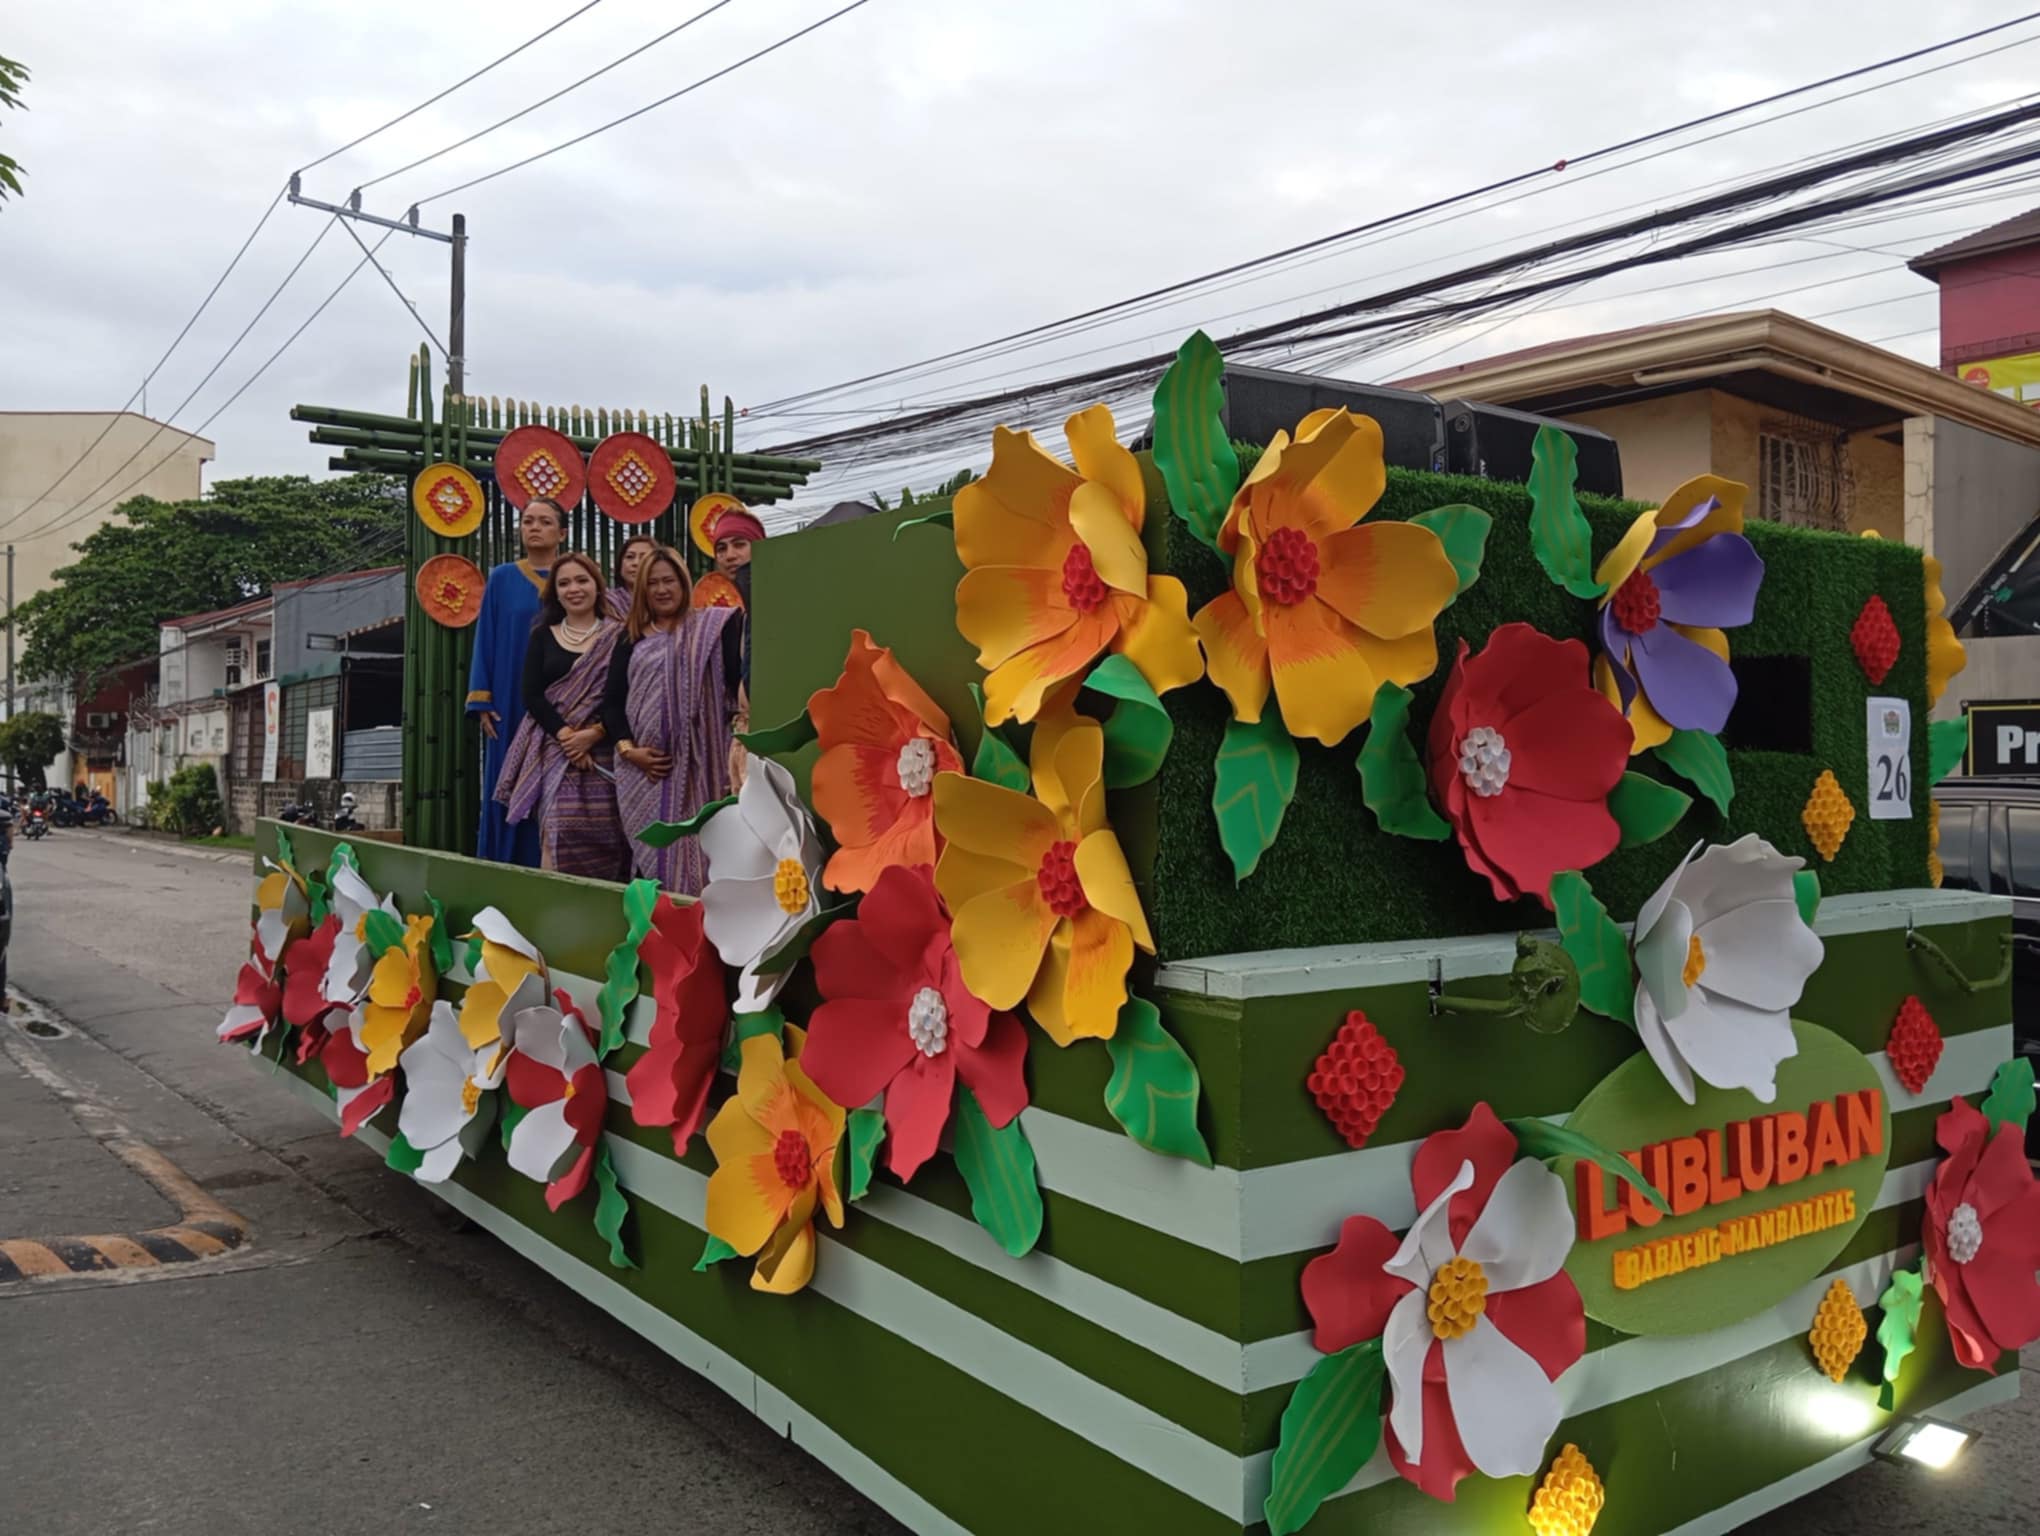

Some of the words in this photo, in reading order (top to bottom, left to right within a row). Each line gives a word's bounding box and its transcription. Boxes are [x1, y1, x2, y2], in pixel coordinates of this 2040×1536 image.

[1876, 754, 1908, 801] 26
[1576, 1089, 1884, 1240] LUBLUBAN
[1614, 1228, 1720, 1290] BABAENG
[1719, 1188, 1856, 1256] MAMBABATAS
